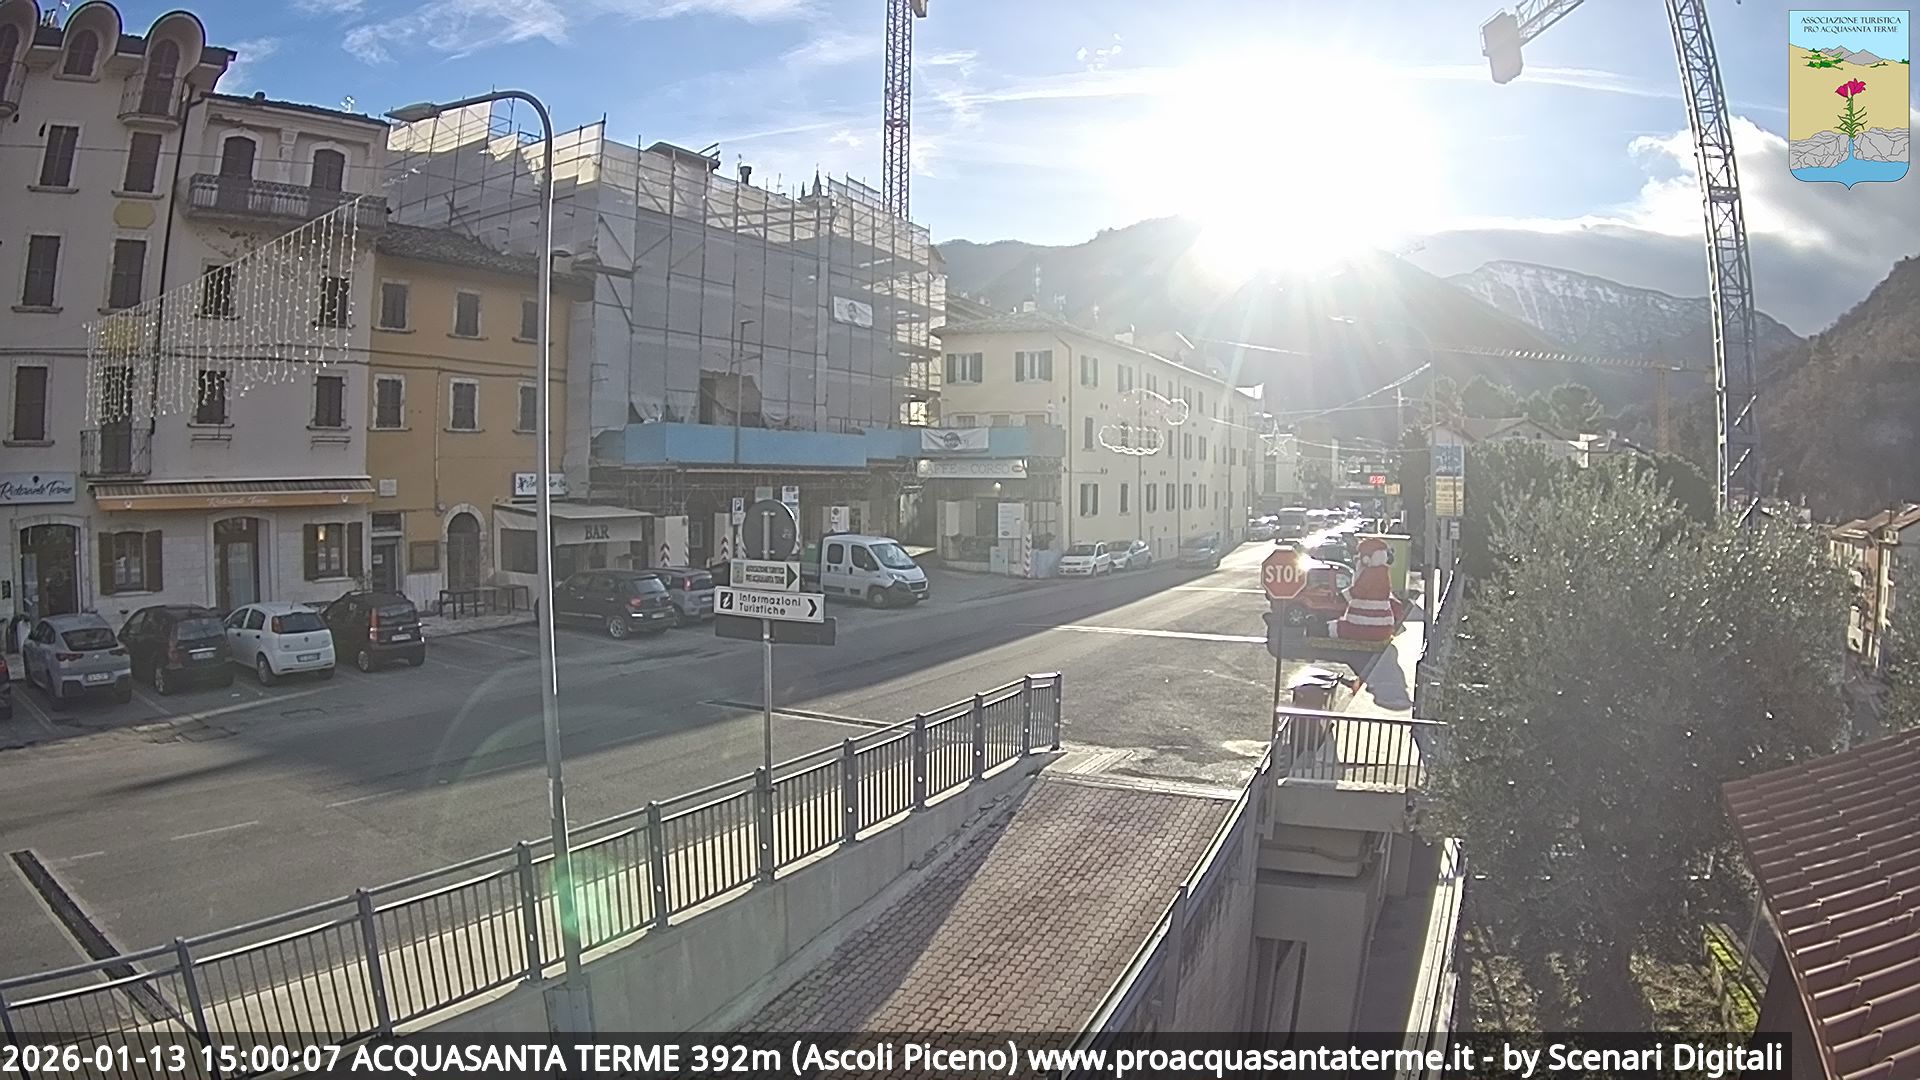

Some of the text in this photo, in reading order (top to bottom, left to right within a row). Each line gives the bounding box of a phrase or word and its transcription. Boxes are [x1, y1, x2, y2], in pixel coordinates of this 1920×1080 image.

[970, 463, 1010, 474] CORSO
[584, 524, 610, 540] BAR
[1265, 565, 1303, 583] STOP
[739, 593, 801, 606] Informazioni
[739, 603, 786, 615] Turistiche
